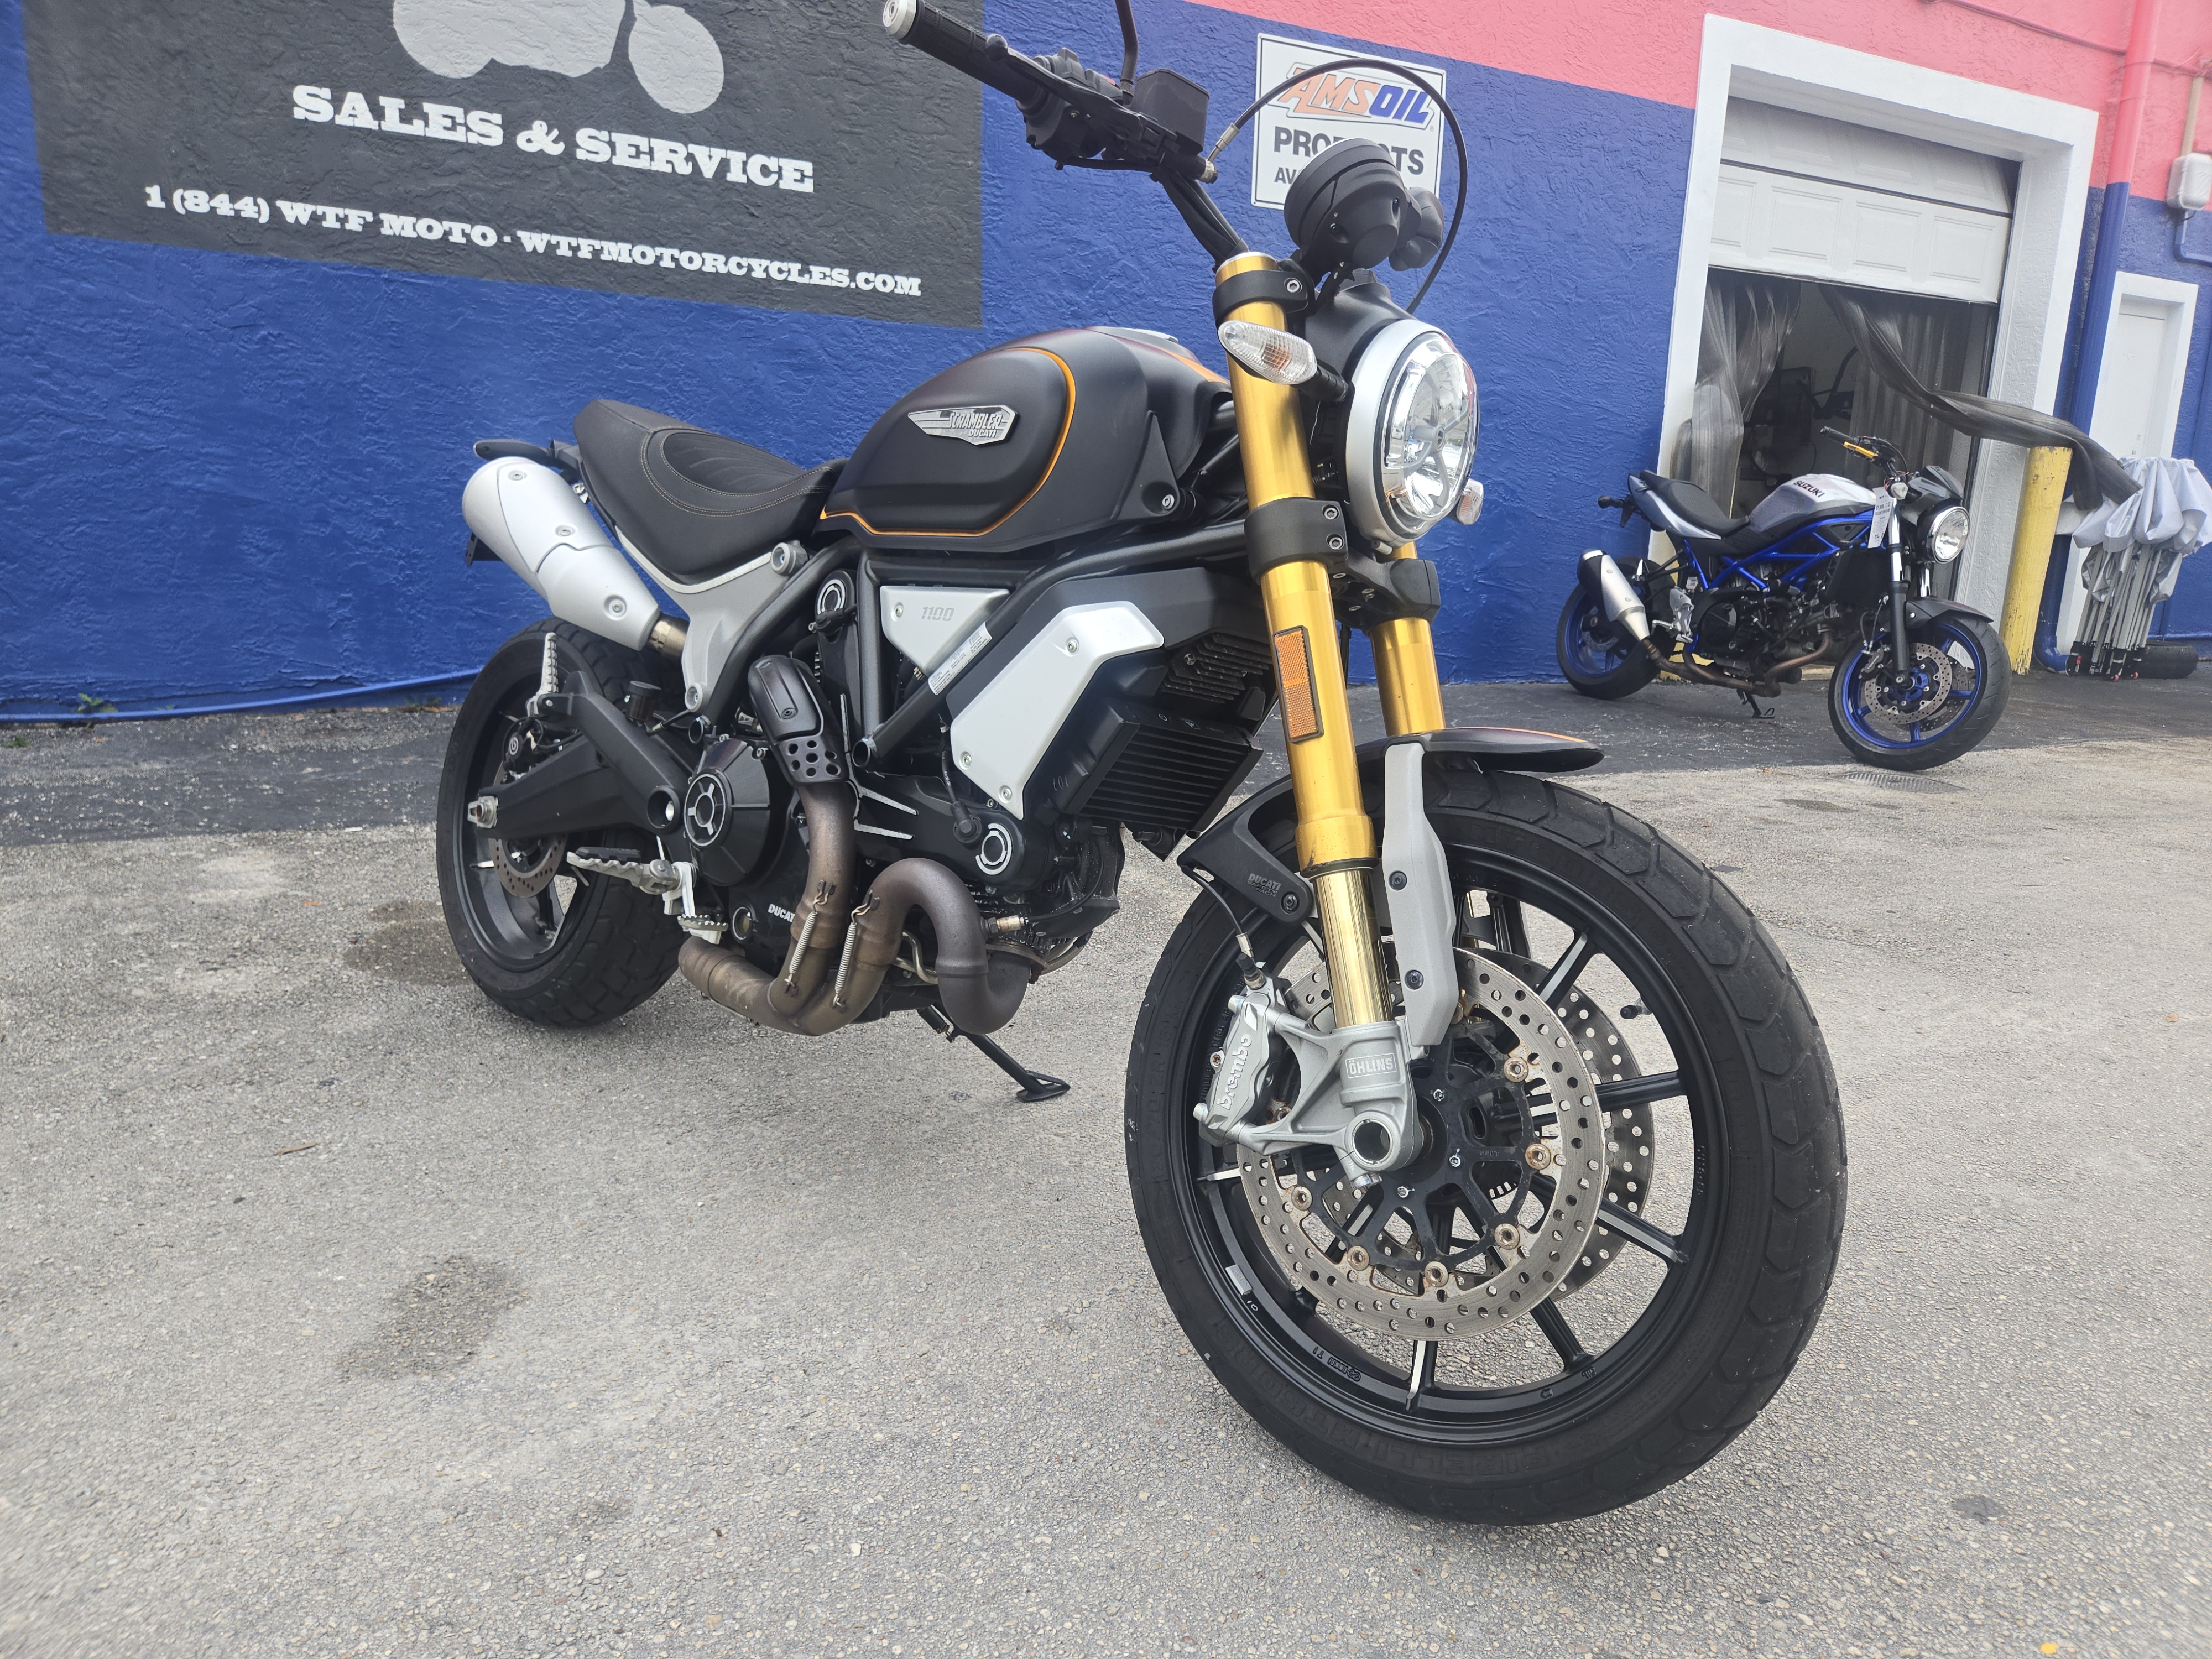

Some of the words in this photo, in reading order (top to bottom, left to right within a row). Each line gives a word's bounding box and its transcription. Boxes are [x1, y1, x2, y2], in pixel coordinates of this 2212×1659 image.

[1279, 68, 1433, 123] AMSOIL
[293, 85, 504, 146] SALES
[516, 121, 565, 155] &
[576, 128, 814, 193] SERVICE
[1274, 126, 1425, 175] PROTS
[145, 185, 166, 208] 1
[173, 189, 270, 223] (844)
[276, 200, 373, 231] WTF
[379, 213, 498, 247] MOTO
[517, 231, 921, 296] WTFMOTORCYCLES.COM
[950, 412, 1003, 429] SCRAMBLER
[968, 429, 997, 438] DUCATI
[1793, 479, 1825, 498] SUZUKI
[921, 606, 955, 622] 1100
[1246, 880, 1278, 894] SAFETY
[1248, 873, 1281, 891] DUCATI
[1255, 888, 1276, 898] PACK
[768, 903, 795, 923] DUCAT
[1217, 1034, 1253, 1110] brembo
[1348, 1055, 1395, 1076] ÖHLINS
